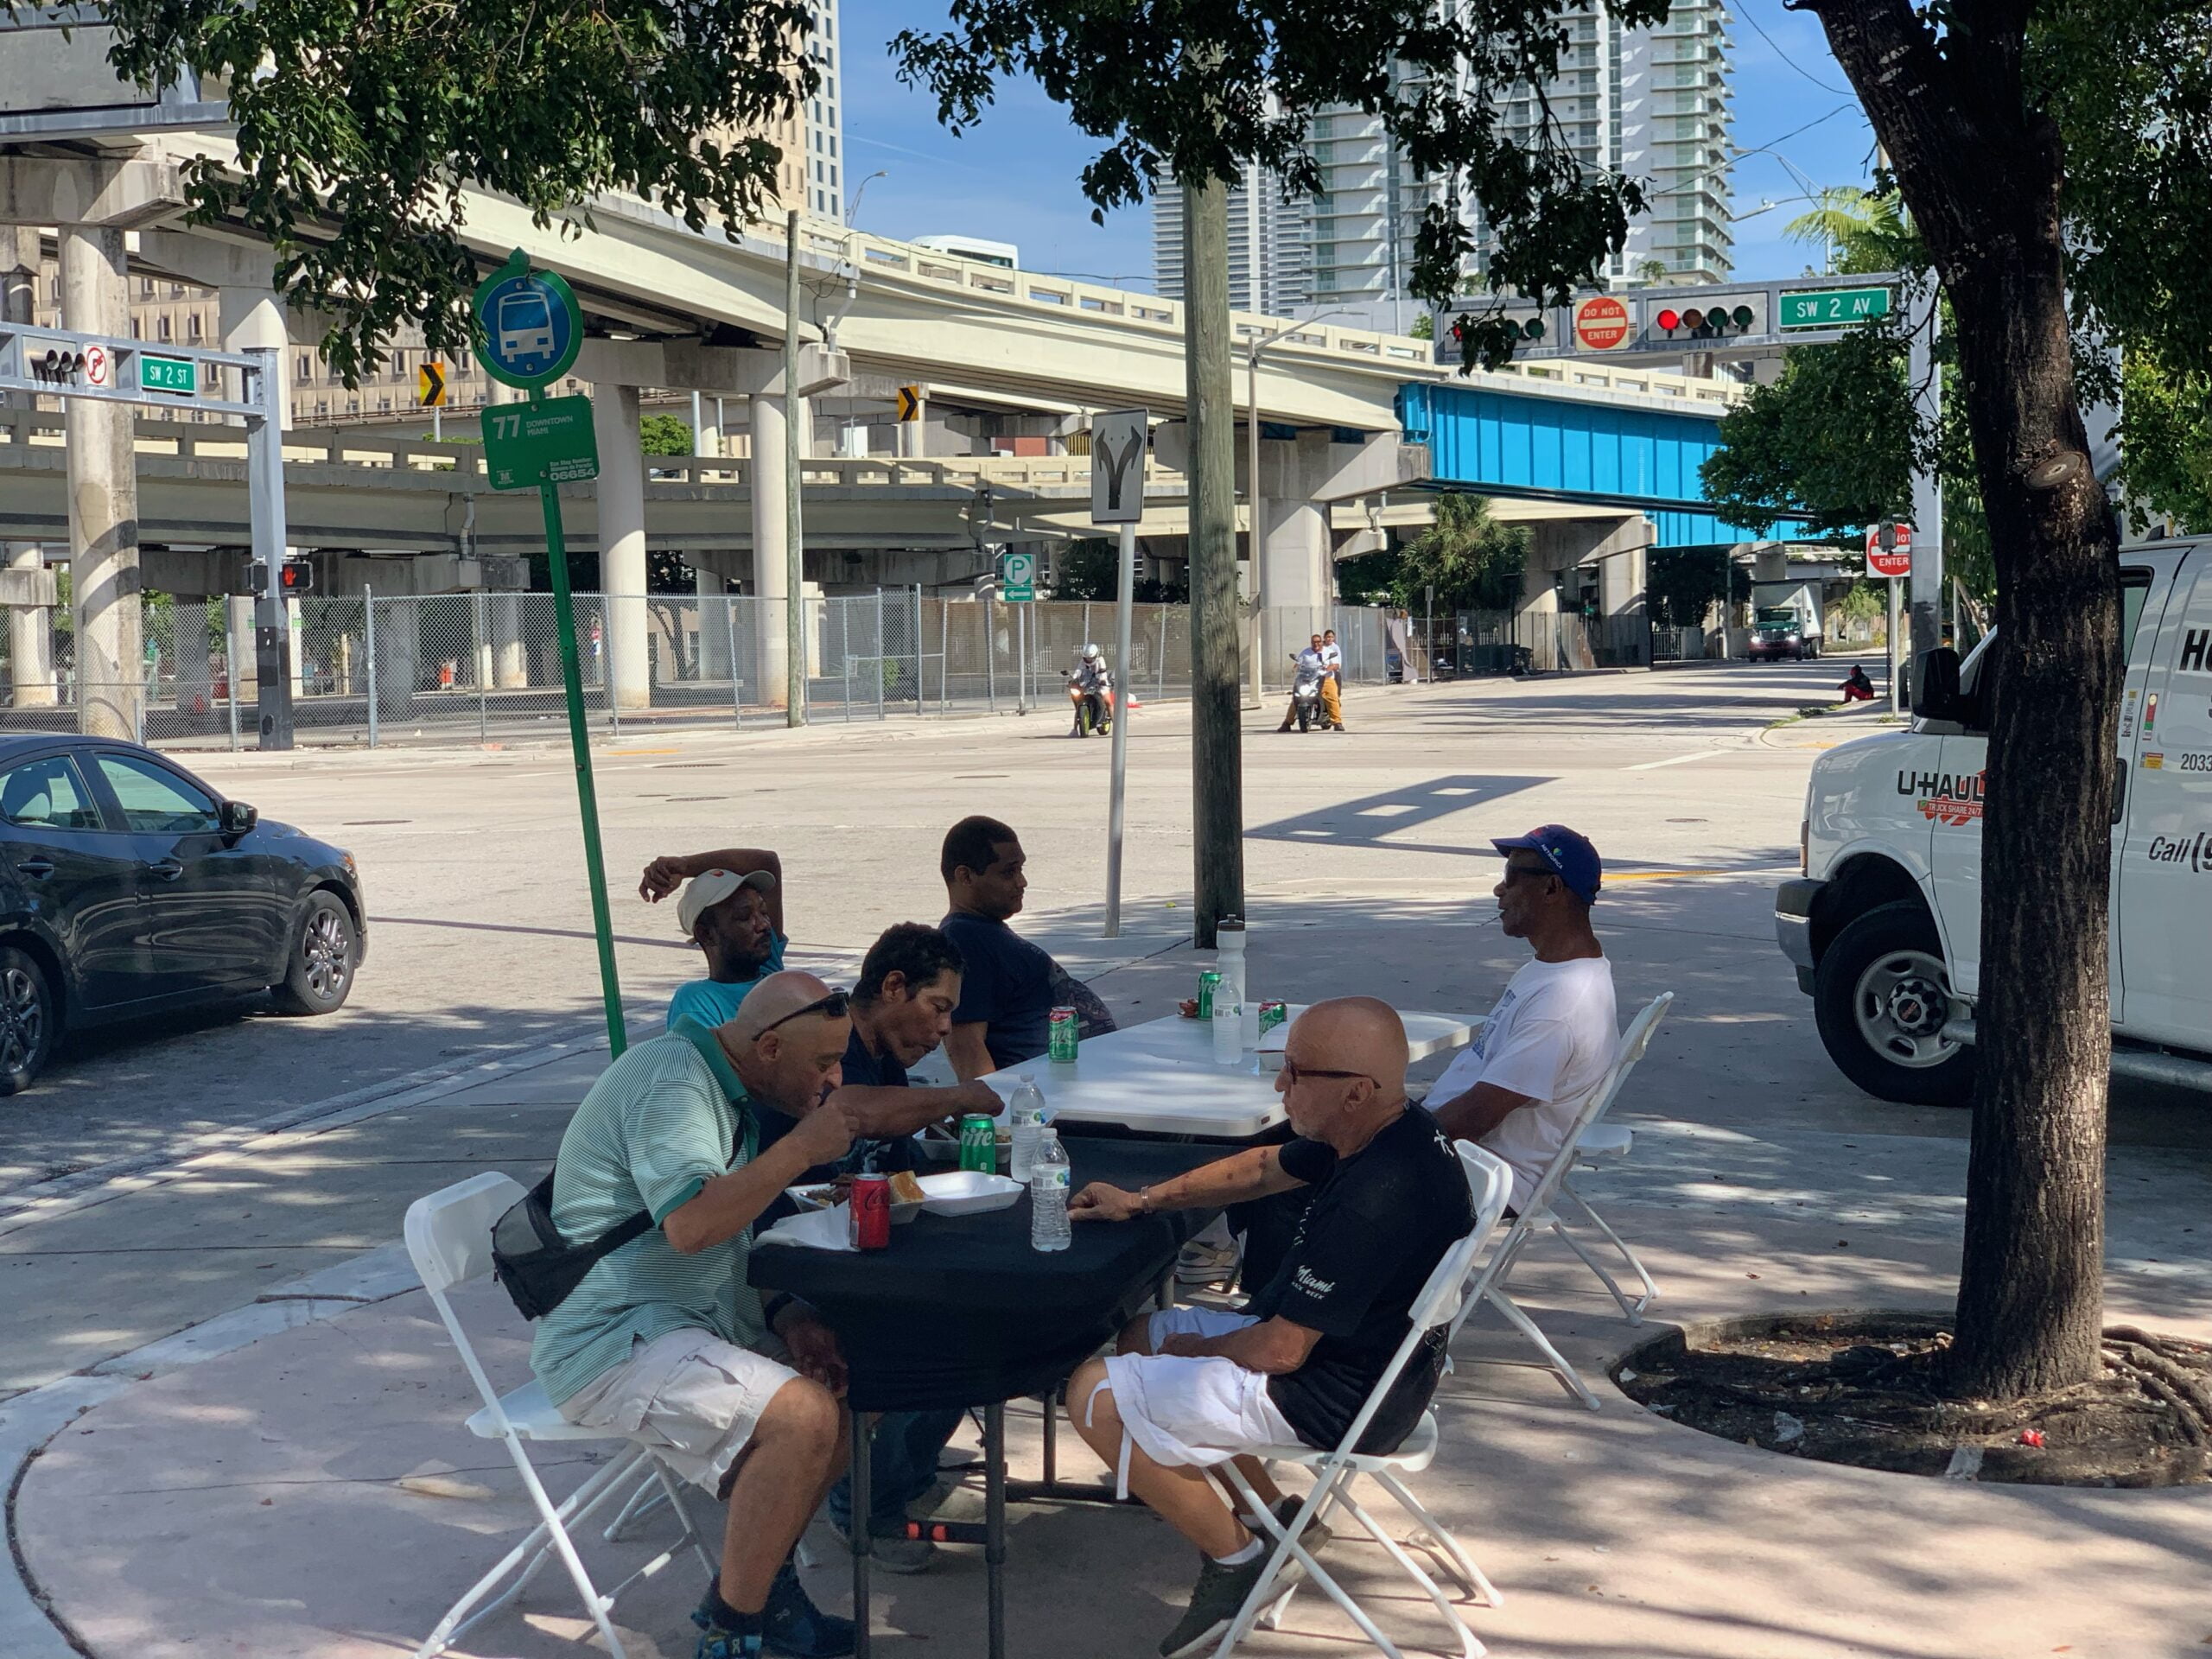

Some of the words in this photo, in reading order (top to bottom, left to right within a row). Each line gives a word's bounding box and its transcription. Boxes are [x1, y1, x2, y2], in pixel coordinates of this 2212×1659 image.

[1584, 308, 1597, 317] DO
[1601, 306, 1620, 316] NOT
[1796, 301, 1818, 318] SW
[1829, 297, 1841, 318] 2
[1852, 297, 1871, 315] AV
[1587, 330, 1618, 340] ENTER
[149, 365, 162, 381] SW
[166, 365, 174, 385] 2
[177, 368, 188, 385] ST
[493, 414, 521, 440] 77
[525, 415, 573, 429] DOWNTOWN
[527, 427, 549, 436] MIAMI
[550, 467, 596, 481] 06654
[1012, 559, 1026, 580] P
[1878, 556, 1909, 567] ENTER
[1929, 803, 1948, 813] TRUCK
[1948, 804, 1967, 815] SHARE
[2148, 836, 2191, 863] Call
[1297, 1264, 1337, 1293] Miami
